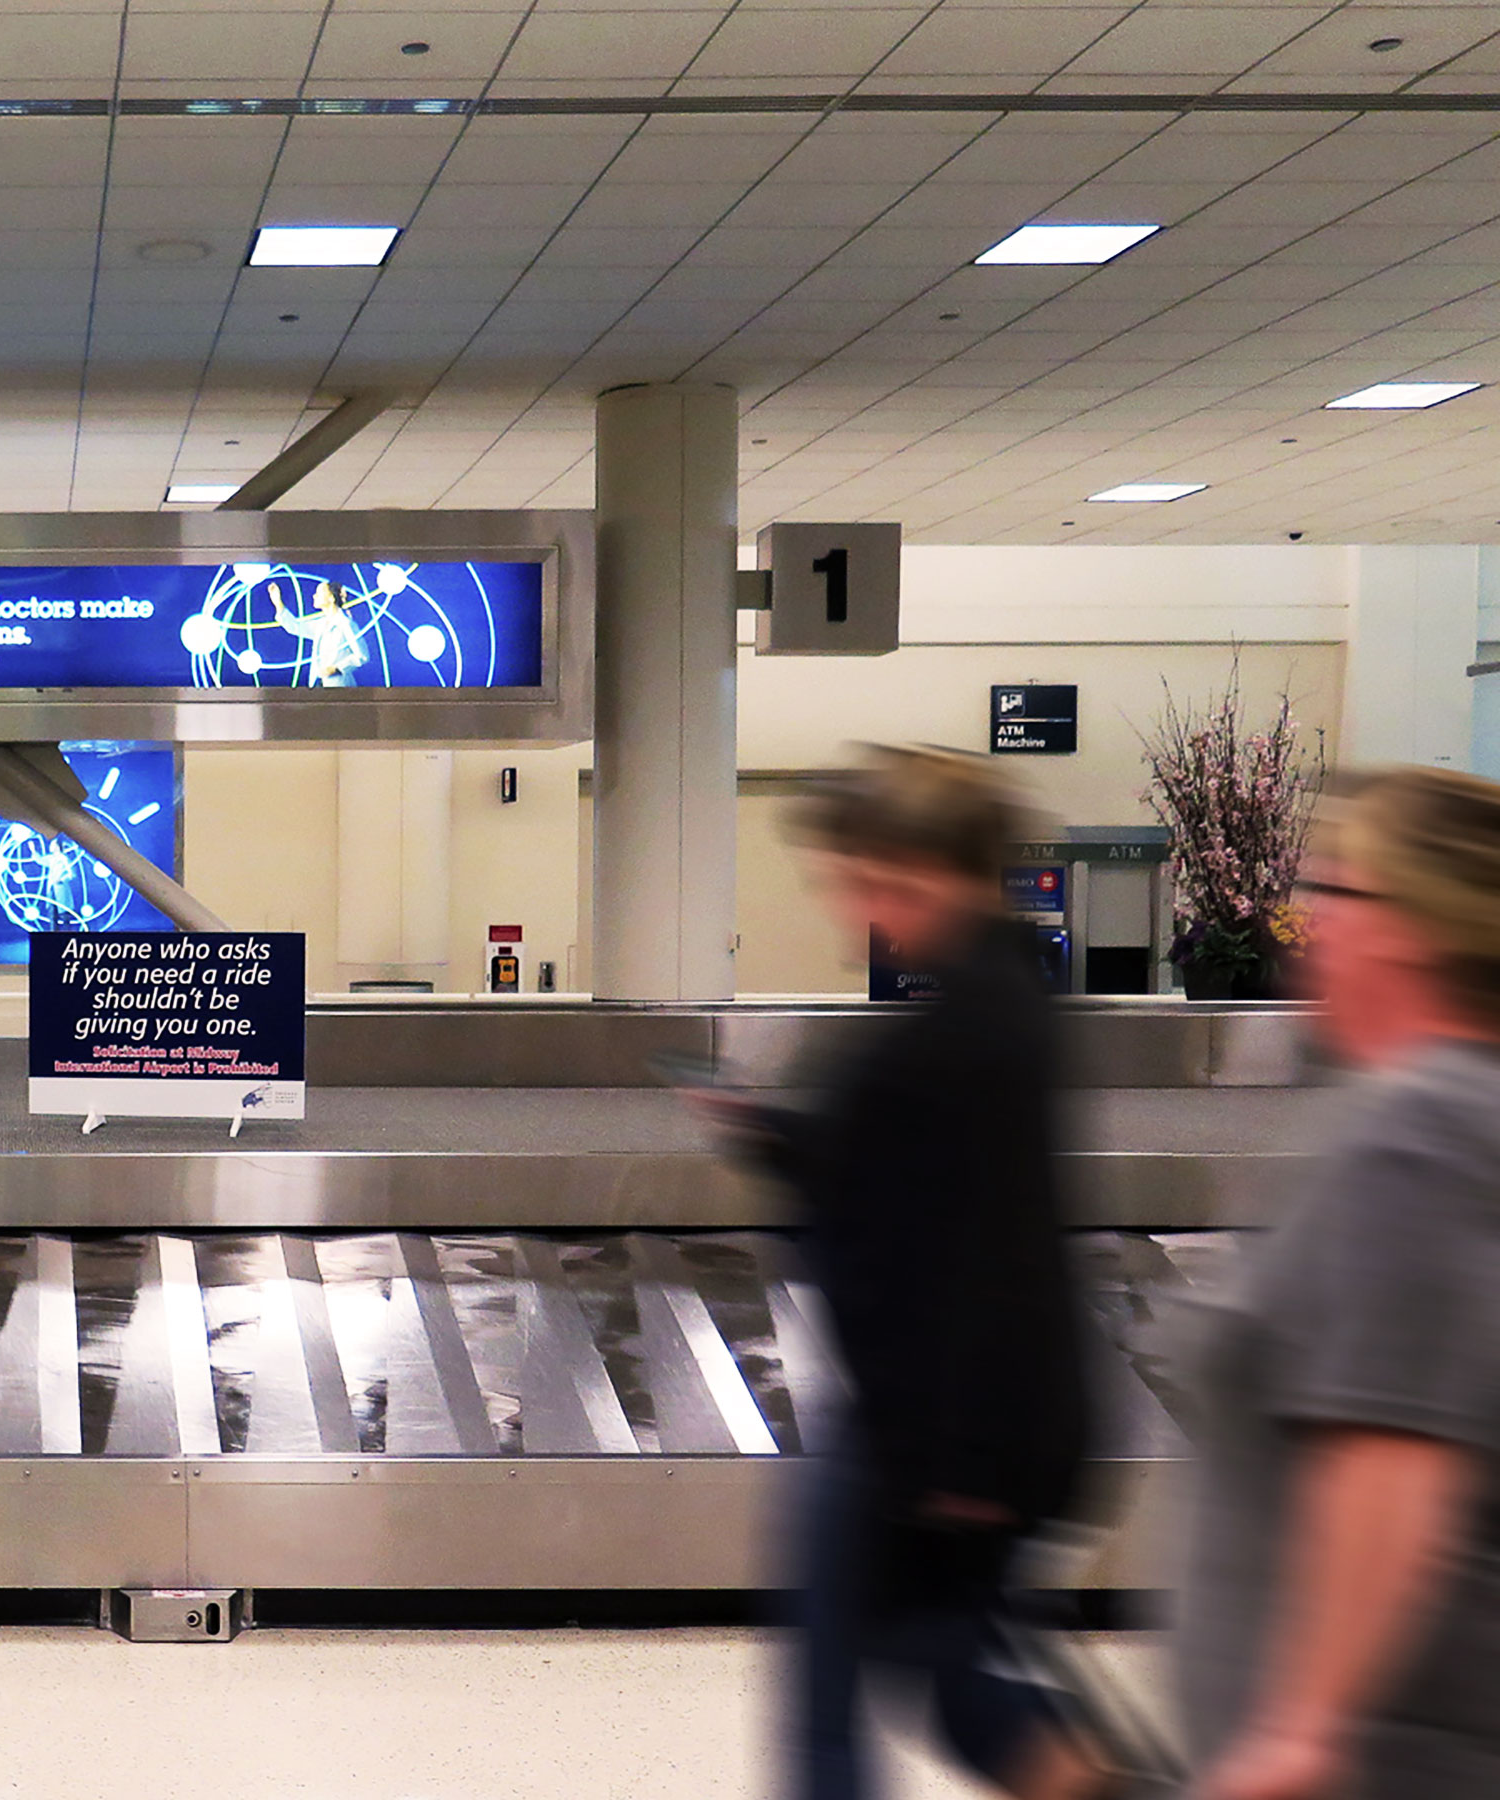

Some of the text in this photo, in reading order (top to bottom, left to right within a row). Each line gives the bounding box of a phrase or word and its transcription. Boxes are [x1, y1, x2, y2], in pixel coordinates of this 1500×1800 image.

[813, 549, 847, 623] 1
[79, 596, 155, 619] make
[998, 725, 1025, 736] ATM
[997, 737, 1046, 748] Machine
[1021, 846, 1055, 858] ATM
[1109, 846, 1142, 859] ATM
[61, 936, 271, 965] Anyone who asks
[62, 961, 272, 990] if you need a ride
[92, 987, 240, 1010] shouldn't be
[74, 1011, 257, 1040] giving you one.
[93, 1045, 240, 1064] Solicitation at Midway
[54, 1060, 279, 1077] International Airport is Prohibited
